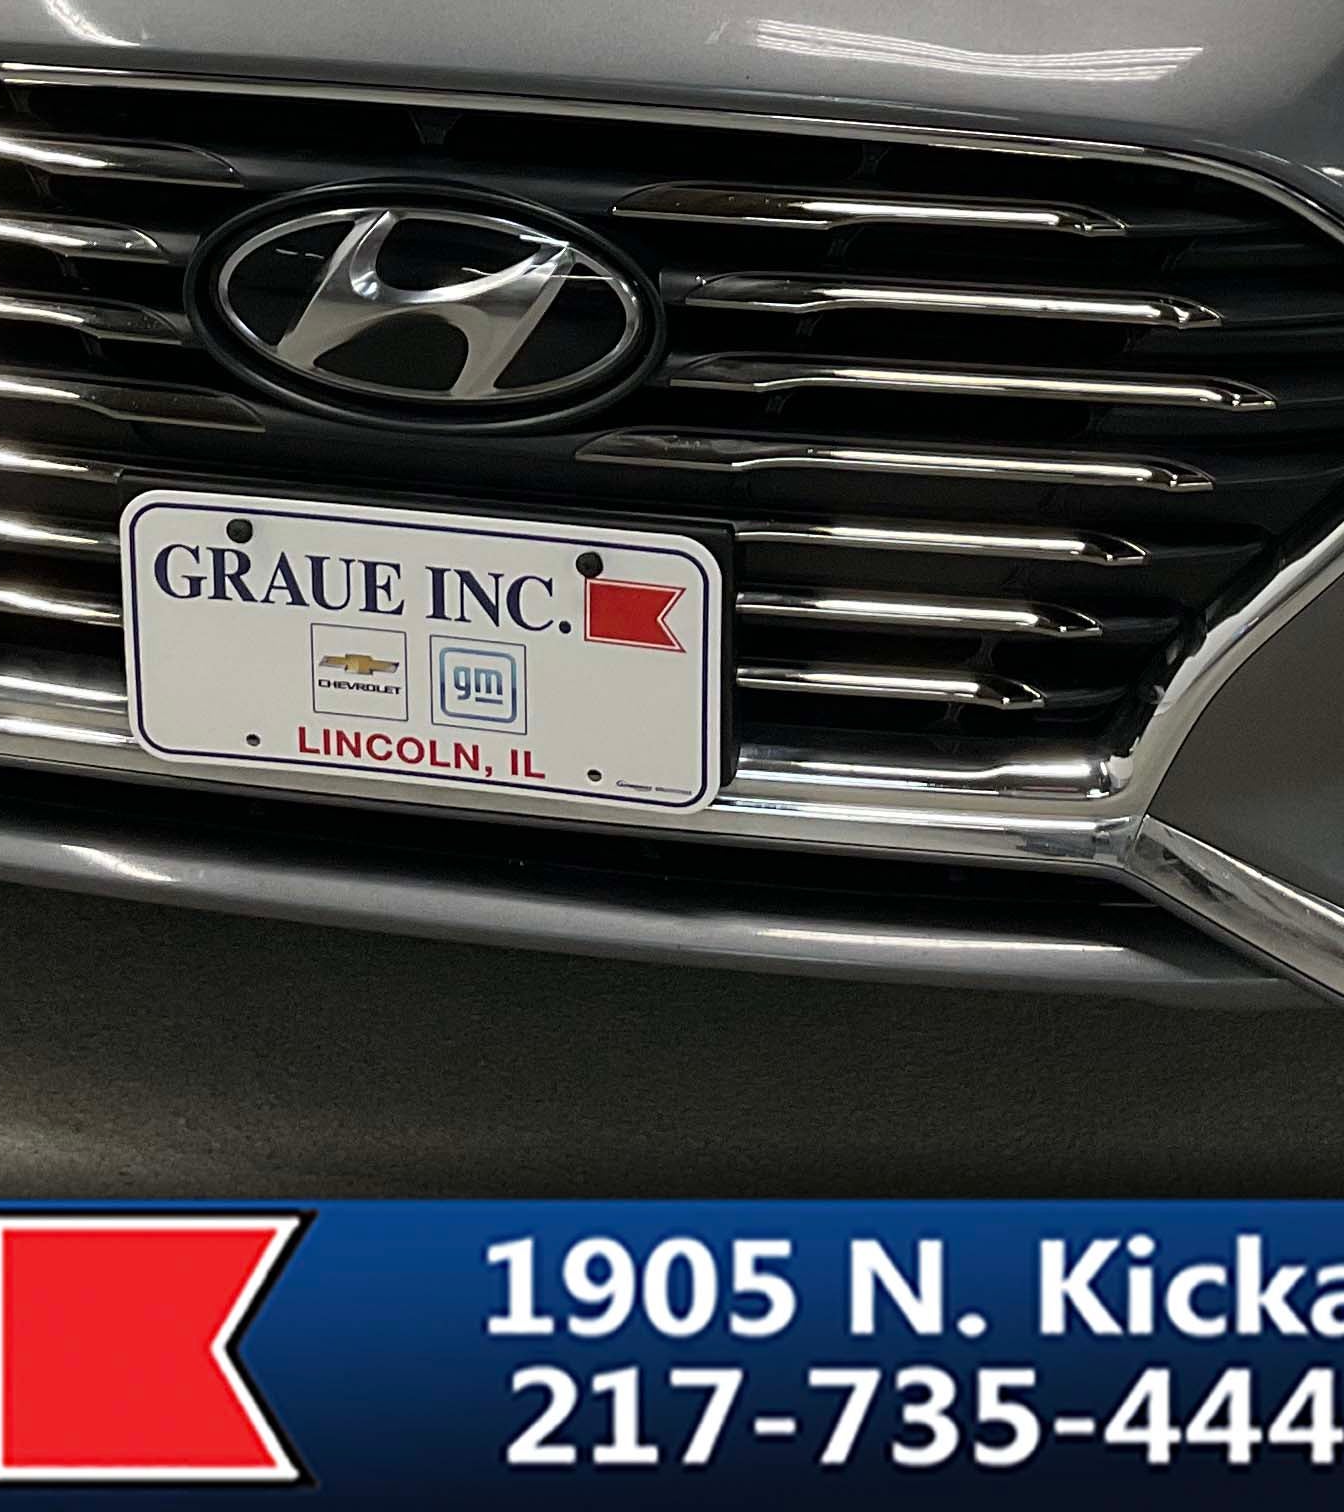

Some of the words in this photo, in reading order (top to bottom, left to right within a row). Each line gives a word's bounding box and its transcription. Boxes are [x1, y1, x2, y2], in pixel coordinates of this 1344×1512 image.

[154, 543, 407, 617] GRAUE
[424, 566, 573, 636] INC.
[317, 678, 403, 696] CHEVROLET
[452, 665, 504, 705] gm
[297, 726, 495, 778] LINCOLN,
[510, 749, 546, 780] IL
